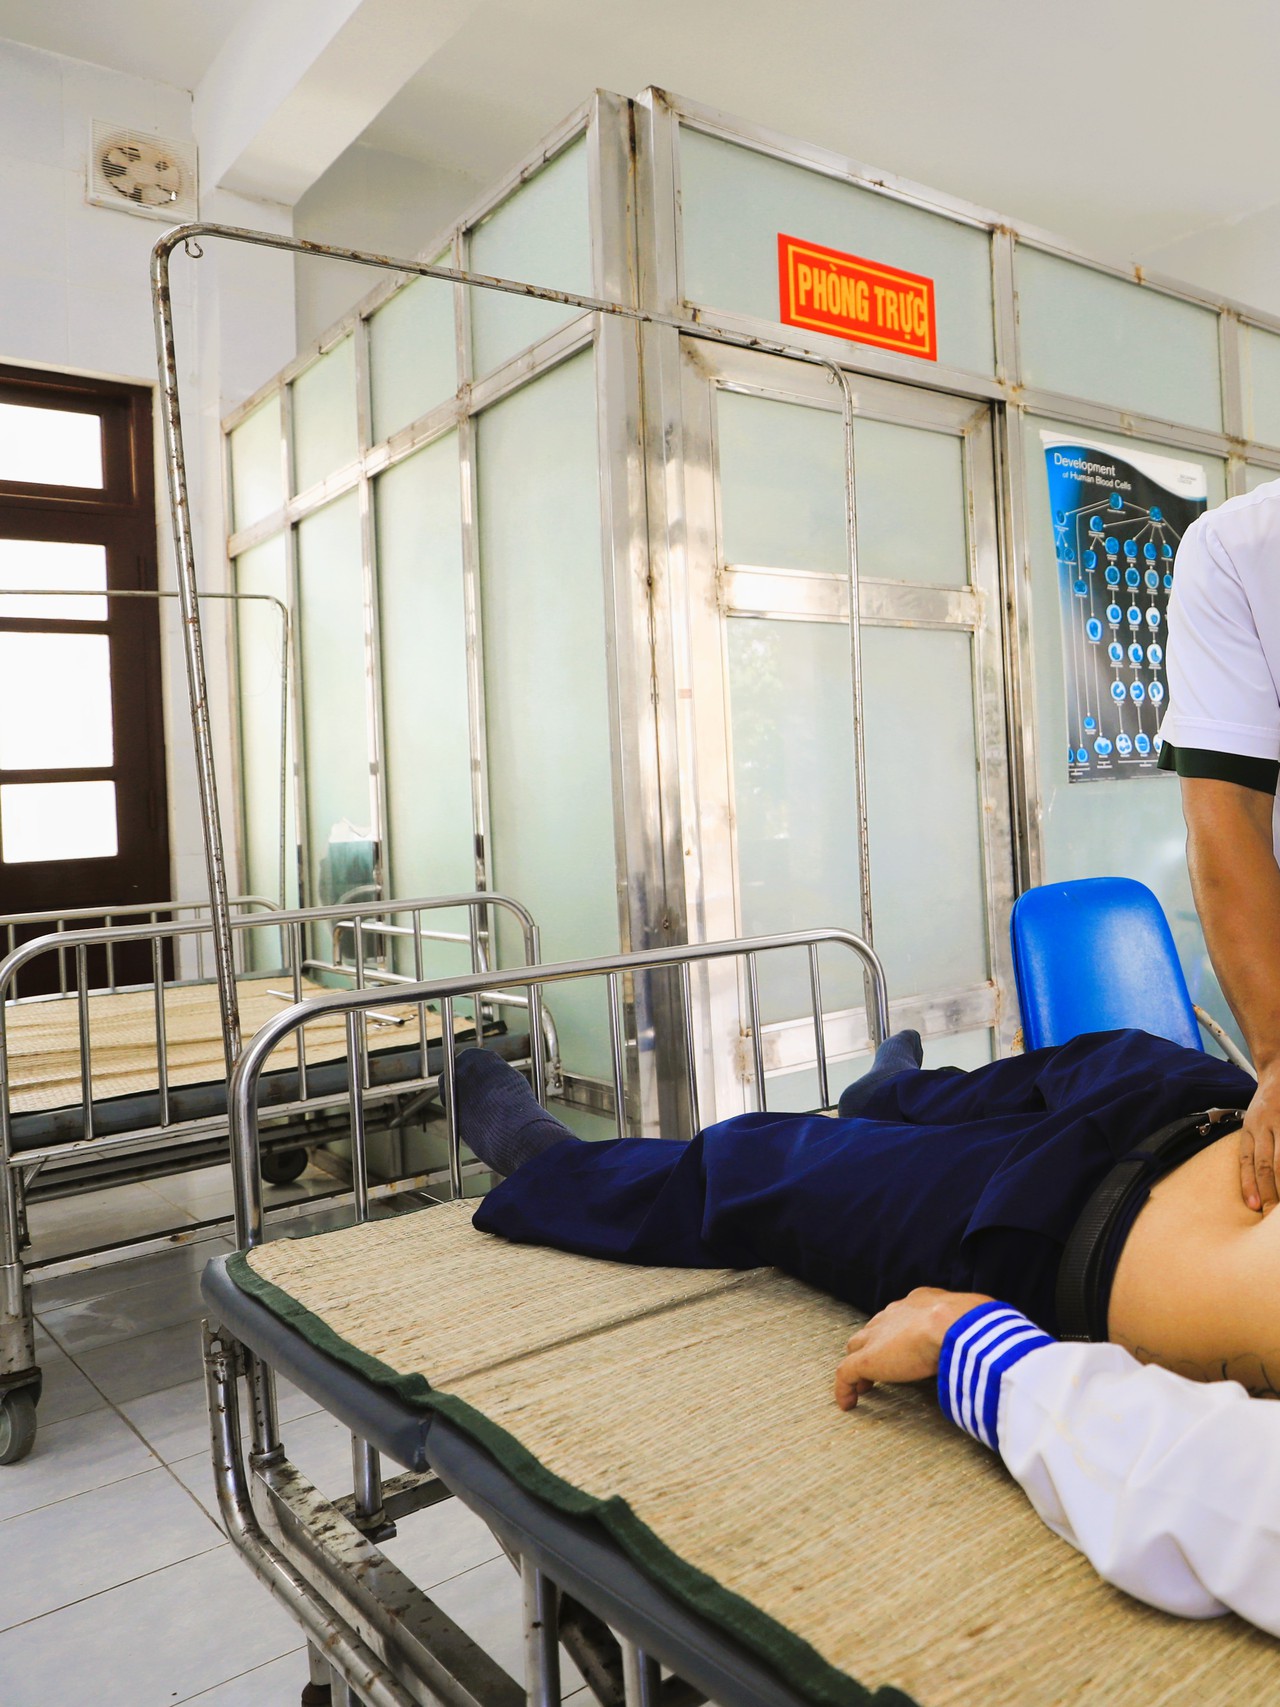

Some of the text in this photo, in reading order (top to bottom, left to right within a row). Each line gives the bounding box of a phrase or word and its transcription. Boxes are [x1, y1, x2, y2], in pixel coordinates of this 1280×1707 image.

[797, 263, 926, 340] PHÒNG TRỰC
[1054, 452, 1116, 477] Development
[1062, 471, 1132, 491] of Human Blood Cells
